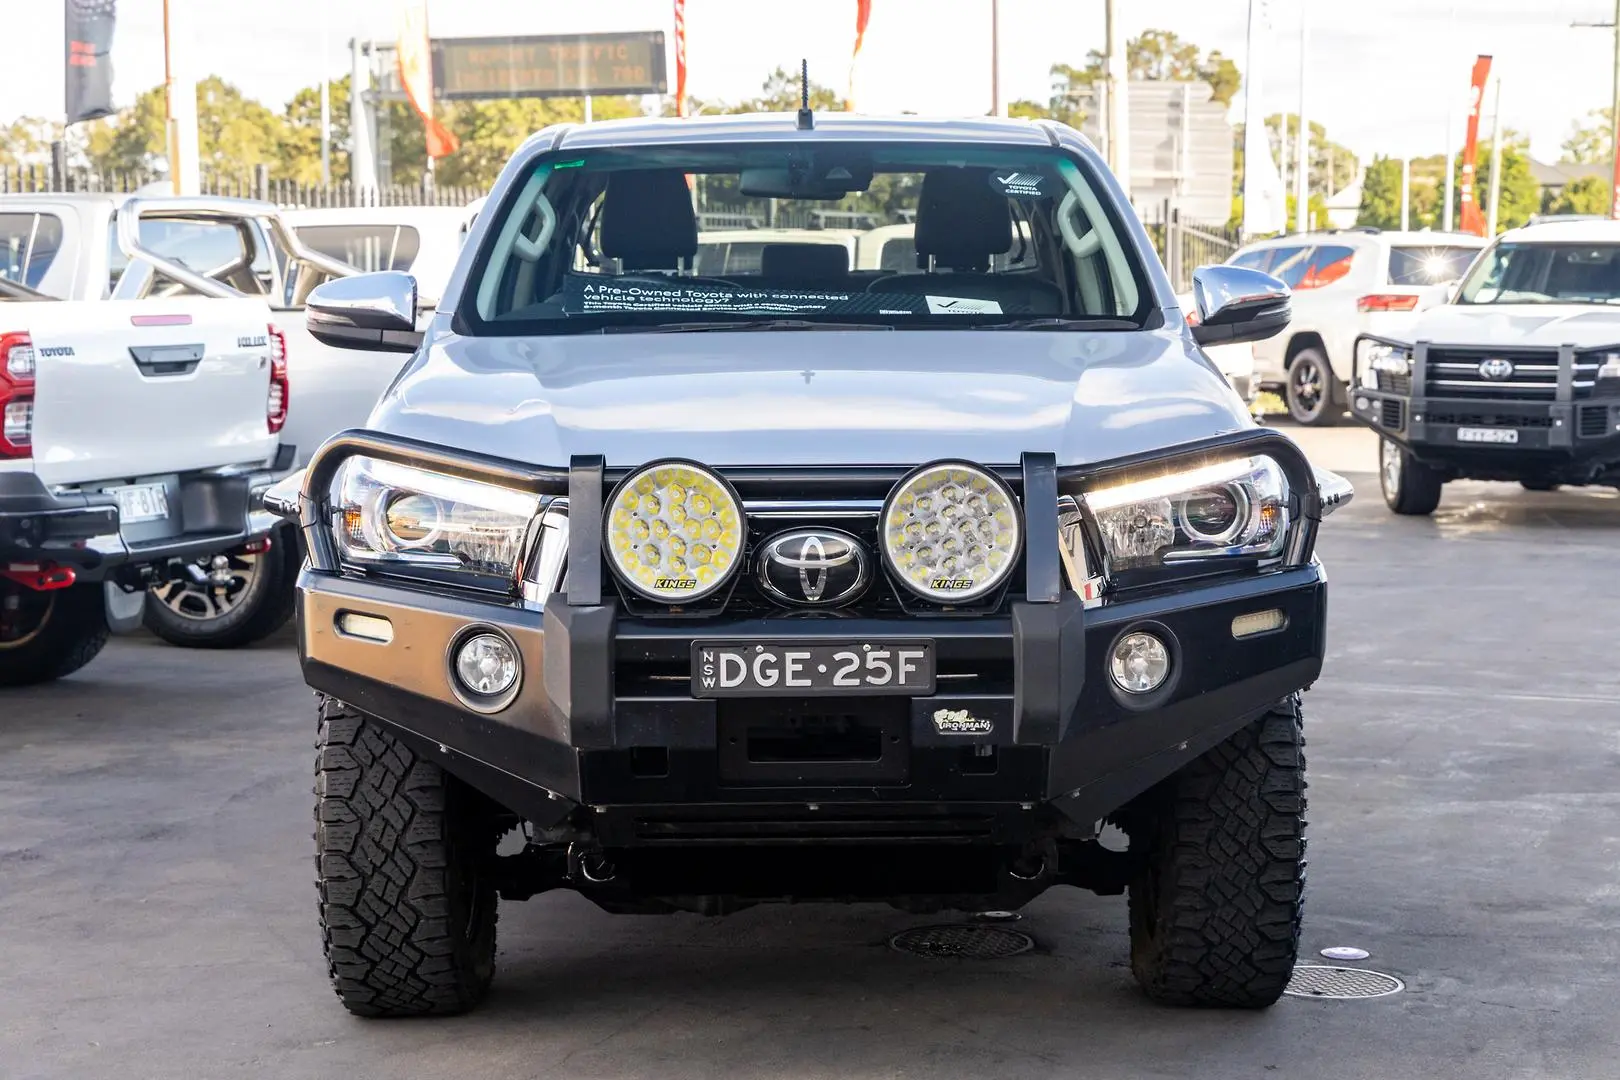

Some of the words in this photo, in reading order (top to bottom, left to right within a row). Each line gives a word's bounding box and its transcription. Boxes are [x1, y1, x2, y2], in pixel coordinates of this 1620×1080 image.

[599, 285, 681, 297] Pre-Owned
[686, 290, 733, 299] Toyota
[640, 296, 730, 304] technology?
[40, 347, 75, 357] TOYOTA
[655, 579, 696, 588] KINGS
[931, 580, 972, 589] KINGS
[702, 651, 715, 688] NSW
